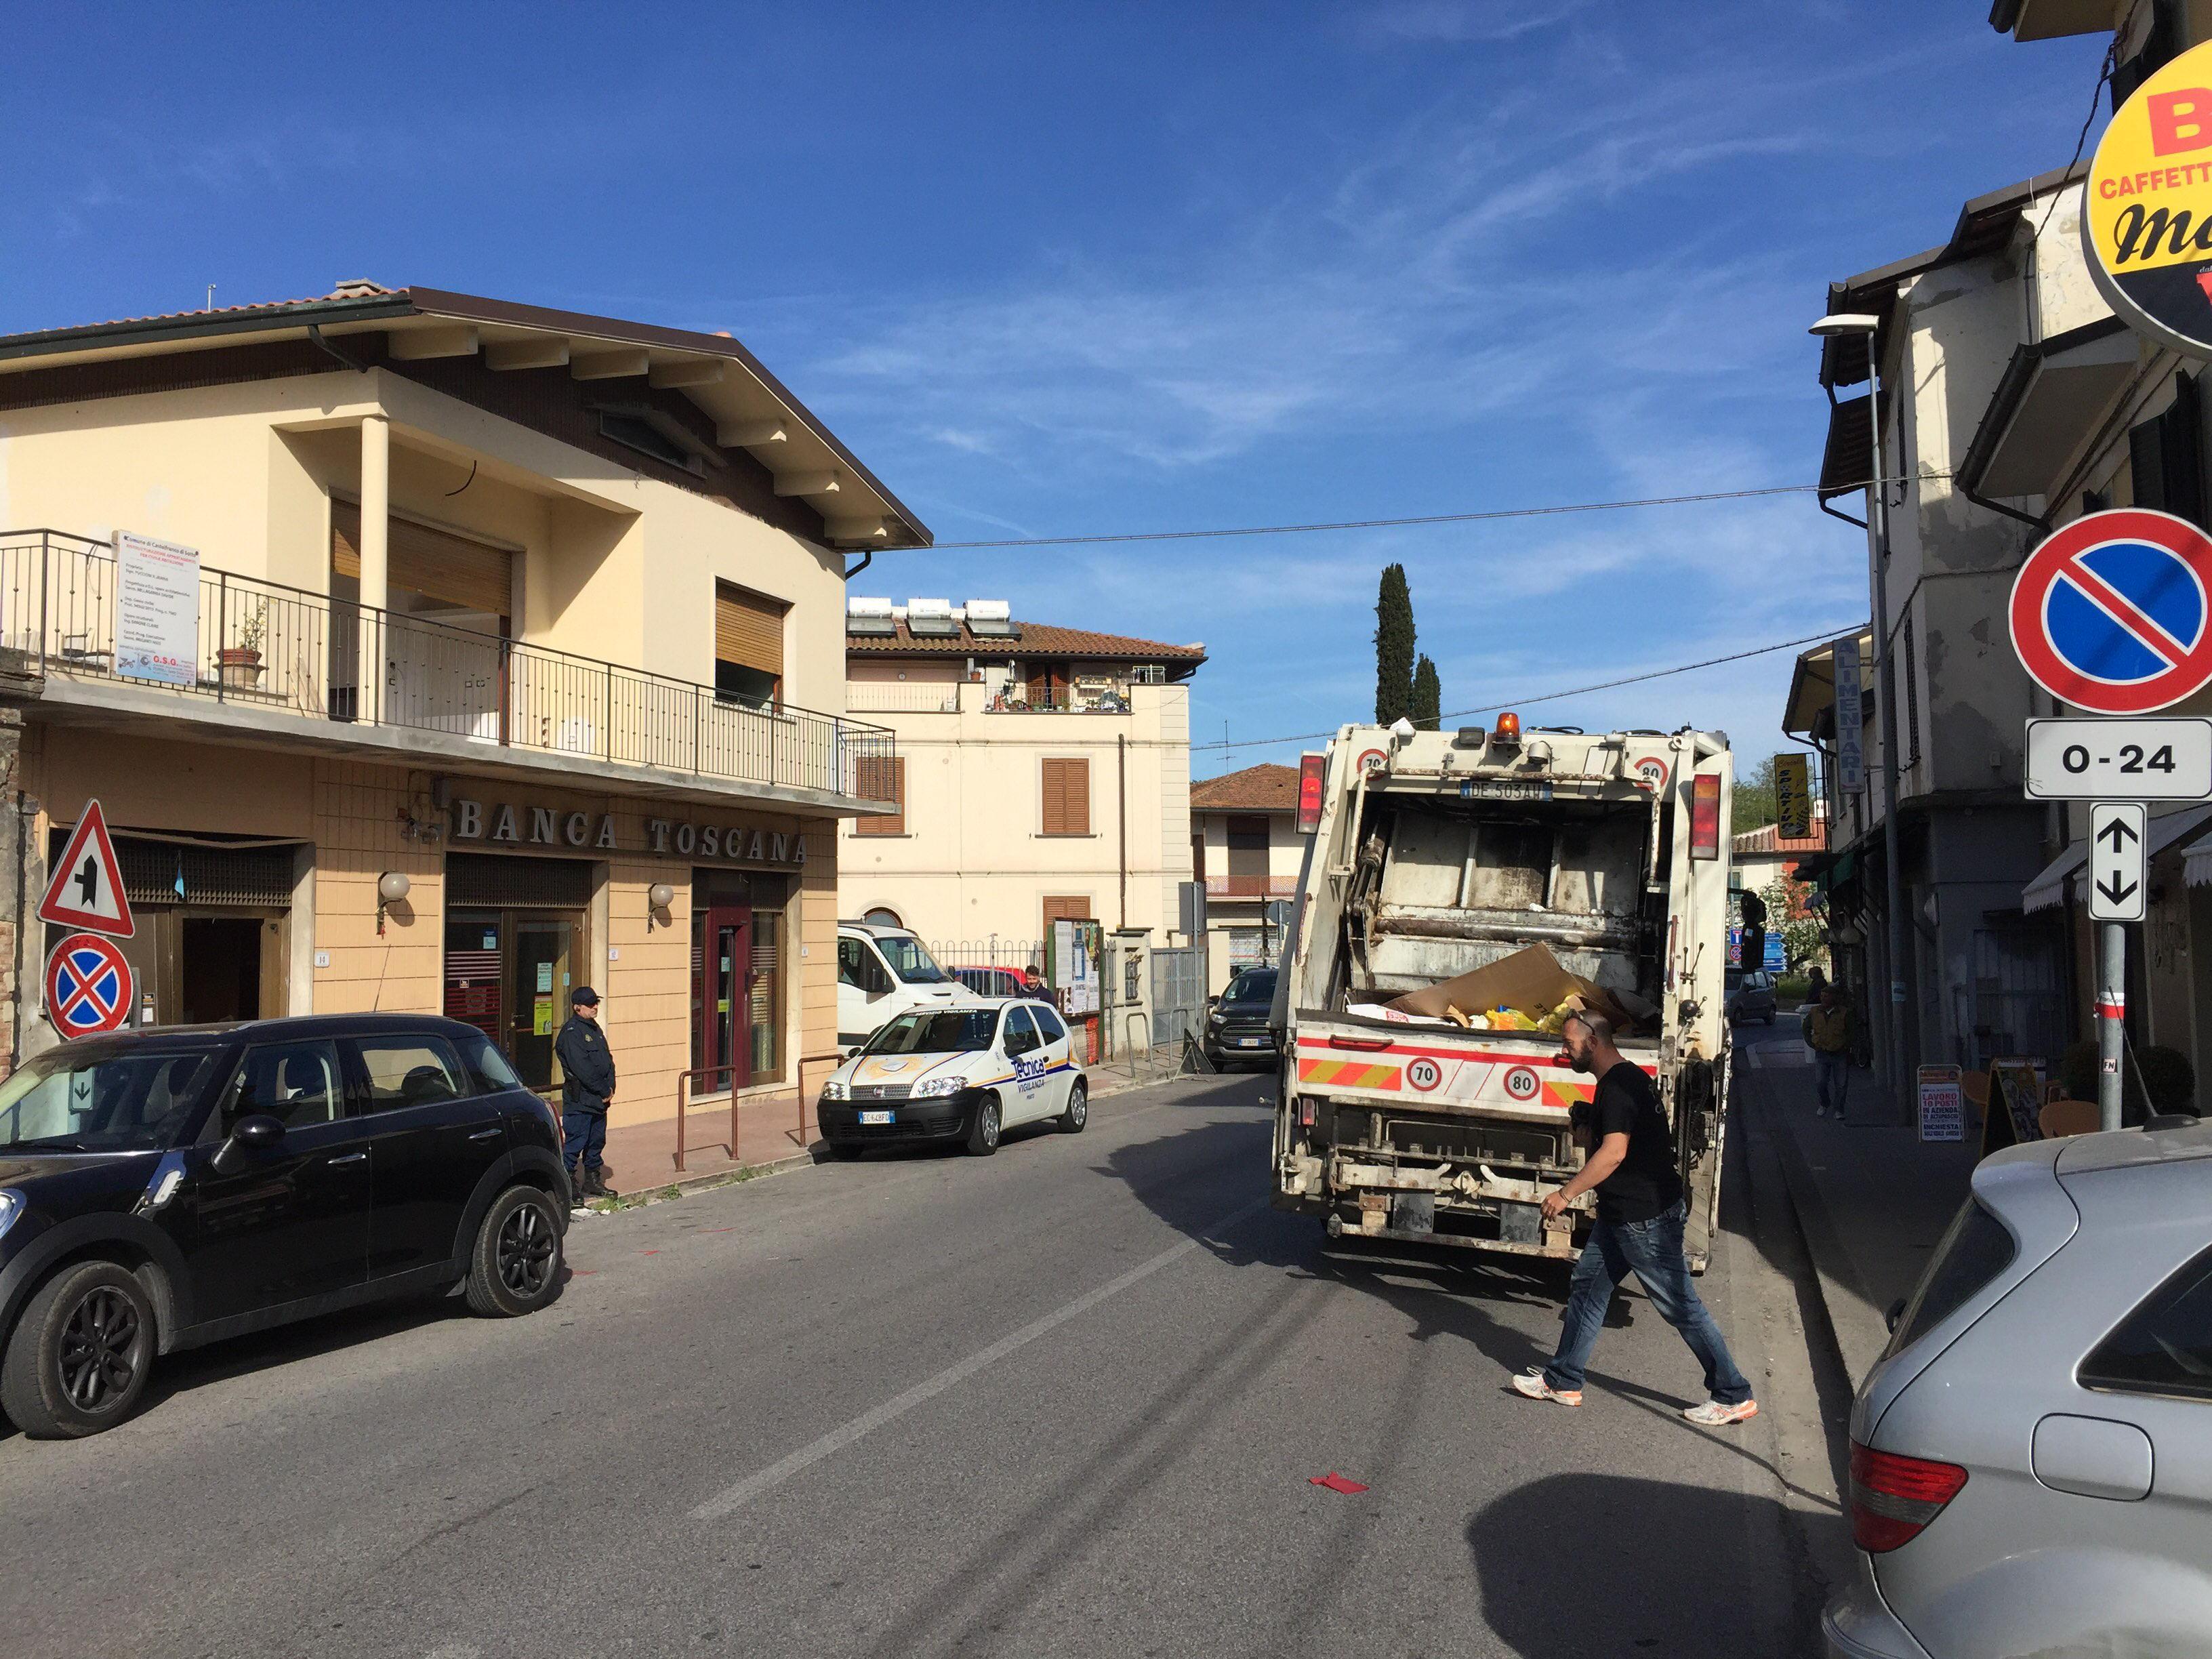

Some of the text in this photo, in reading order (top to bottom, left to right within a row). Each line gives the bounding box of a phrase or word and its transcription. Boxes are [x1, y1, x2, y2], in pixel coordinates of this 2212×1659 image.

[1837, 640, 1861, 783] ALIMENTARI
[457, 800, 807, 863] BANCA TOSCANA
[1010, 1057, 1044, 1078] Tecnica
[1416, 1066, 1433, 1082] 70
[1018, 1079, 1044, 1093] VIGILANZA
[1513, 1076, 1532, 1091] 80
